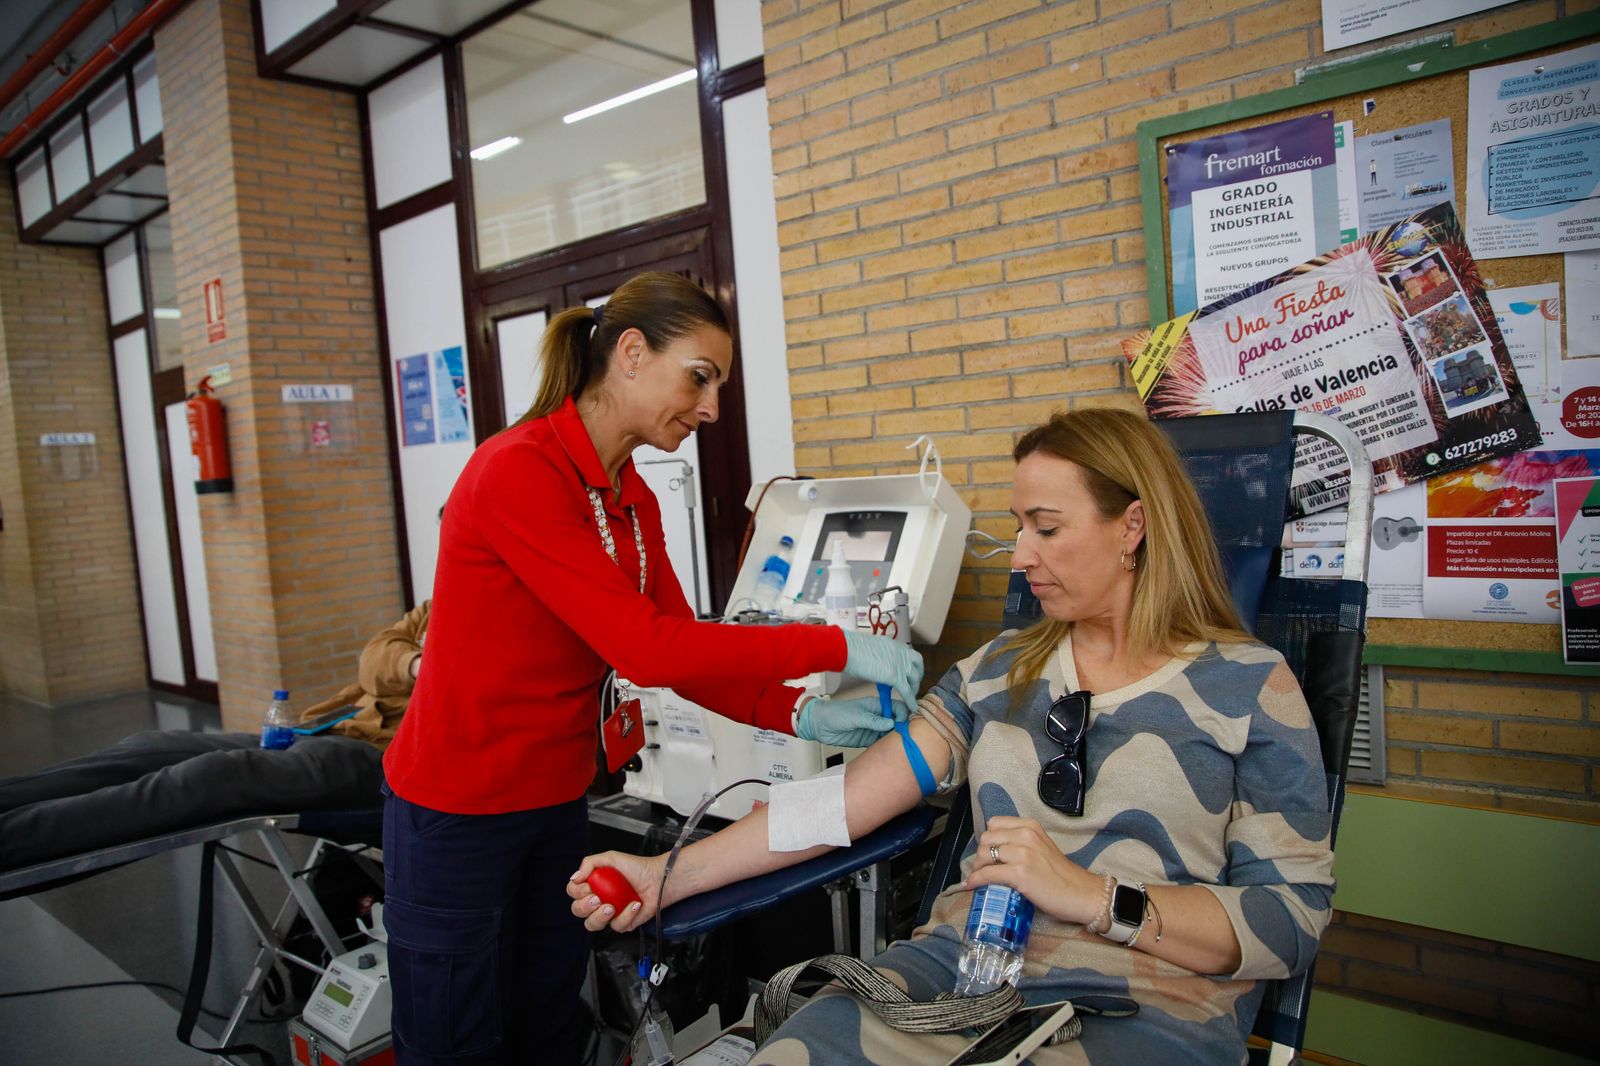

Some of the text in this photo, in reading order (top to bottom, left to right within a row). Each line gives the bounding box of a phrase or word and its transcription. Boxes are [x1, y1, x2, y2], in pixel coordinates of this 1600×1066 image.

[1500, 73, 1598, 97] CONVOCATORIA ORDINARIA
[1504, 79, 1529, 88] CLASES
[1531, 76, 1541, 84] DE
[1507, 87, 1591, 114] GRADOS Y
[1394, 128, 1433, 141] rticulares
[1204, 146, 1281, 179] fremart
[1496, 152, 1530, 162] EMPRESAS
[1535, 150, 1584, 163] CONTABILIDAD
[1260, 155, 1322, 176] formación
[1222, 181, 1277, 201] GRADO
[1495, 178, 1533, 188] MARKETING
[1505, 185, 1540, 194] MERCADOS
[1494, 192, 1535, 201] RELACIONES
[1536, 187, 1572, 196] LABORALES
[1209, 193, 1294, 219] INGENIERÍA
[1494, 199, 1534, 208] RELACIONES
[1211, 210, 1294, 232] INDUSTRIAL
[1208, 231, 1299, 250] COMENZAMOS GRUPOS PARA
[1215, 246, 1249, 256] SIGUIENTE
[1250, 238, 1302, 250] CONVOCATORIA
[1220, 256, 1289, 272] NUEVOS GRUPOS
[1204, 282, 1250, 293] RESISTENCIA
[1225, 280, 1346, 344] Una Fiesta
[1238, 308, 1354, 375] para soñar
[1281, 357, 1324, 380] VIAJE A LAS
[1290, 385, 1313, 405] de
[1315, 354, 1398, 393] Valencia
[287, 387, 340, 399] AULA 1
[1313, 402, 1322, 412] 16
[1323, 397, 1336, 409] DE
[1337, 385, 1366, 406] MARZO
[1358, 403, 1380, 415] WHISKY
[1385, 392, 1410, 406] GINEBRA
[1346, 400, 1418, 429] NUMENTAL POR LA CIUDAD
[1360, 428, 1369, 437] DE
[1369, 424, 1379, 433] SER
[1386, 430, 1394, 438] EN
[1395, 426, 1406, 436] LAS
[1406, 418, 1428, 431] CALLES
[1303, 443, 1322, 455] DE LAS
[1444, 428, 1518, 460] 627279283
[1309, 447, 1343, 463] EN LAS FALL
[1317, 456, 1349, 471] DE VALENC
[1324, 477, 1350, 490] RESERV
[1446, 530, 1475, 538] Impartido
[1580, 594, 1600, 602] afiliado
[772, 764, 788, 772] CTTC
